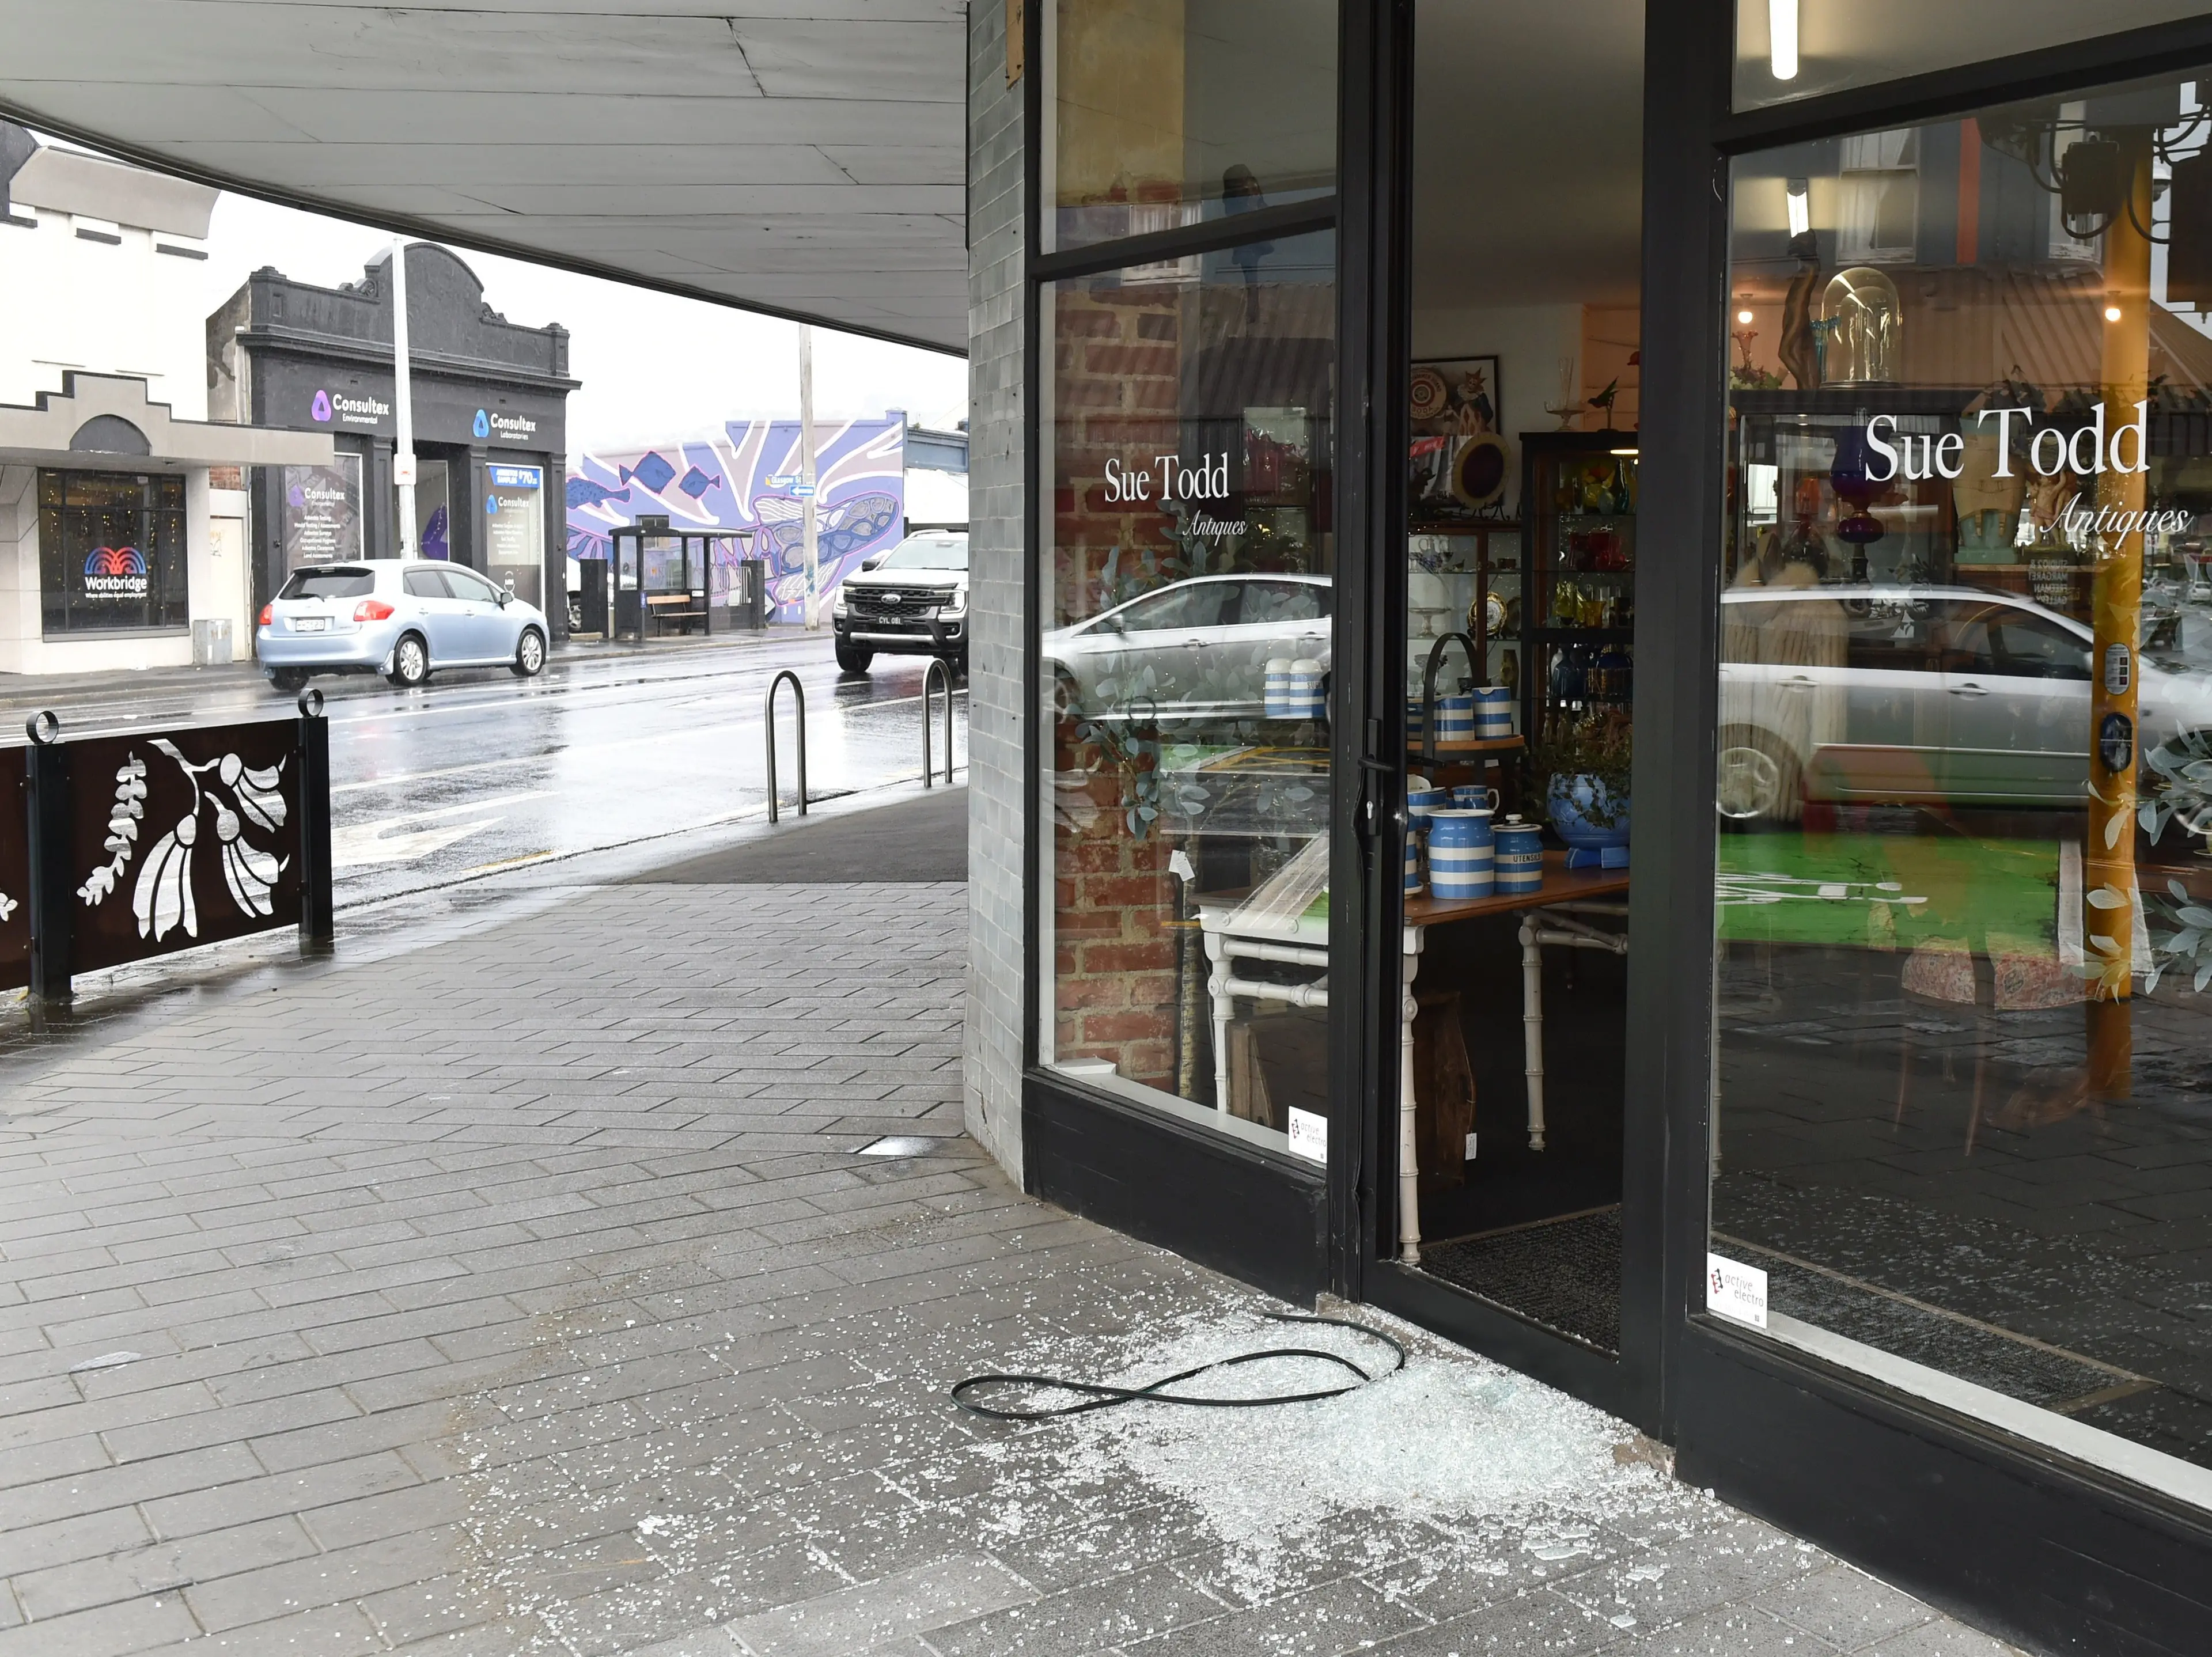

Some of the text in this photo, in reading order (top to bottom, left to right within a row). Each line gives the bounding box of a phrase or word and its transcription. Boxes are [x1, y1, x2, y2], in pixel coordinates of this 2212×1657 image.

[332, 393, 389, 415] Consultex
[342, 413, 378, 424] Environmental
[490, 413, 536, 432] Consultex
[500, 430, 529, 440] Laboratories
[1865, 399, 2152, 482] Sue Todd
[1104, 452, 1230, 503] Sue Todd
[304, 487, 345, 500] Consultex
[498, 496, 529, 507] Consultex
[1182, 509, 1248, 547] Antiques
[2039, 491, 2195, 551] Antiques
[85, 575, 147, 592] Workbridge
[1301, 1123, 1320, 1135] active
[1725, 1275, 1753, 1292] active
[1734, 1289, 1764, 1307] electro
